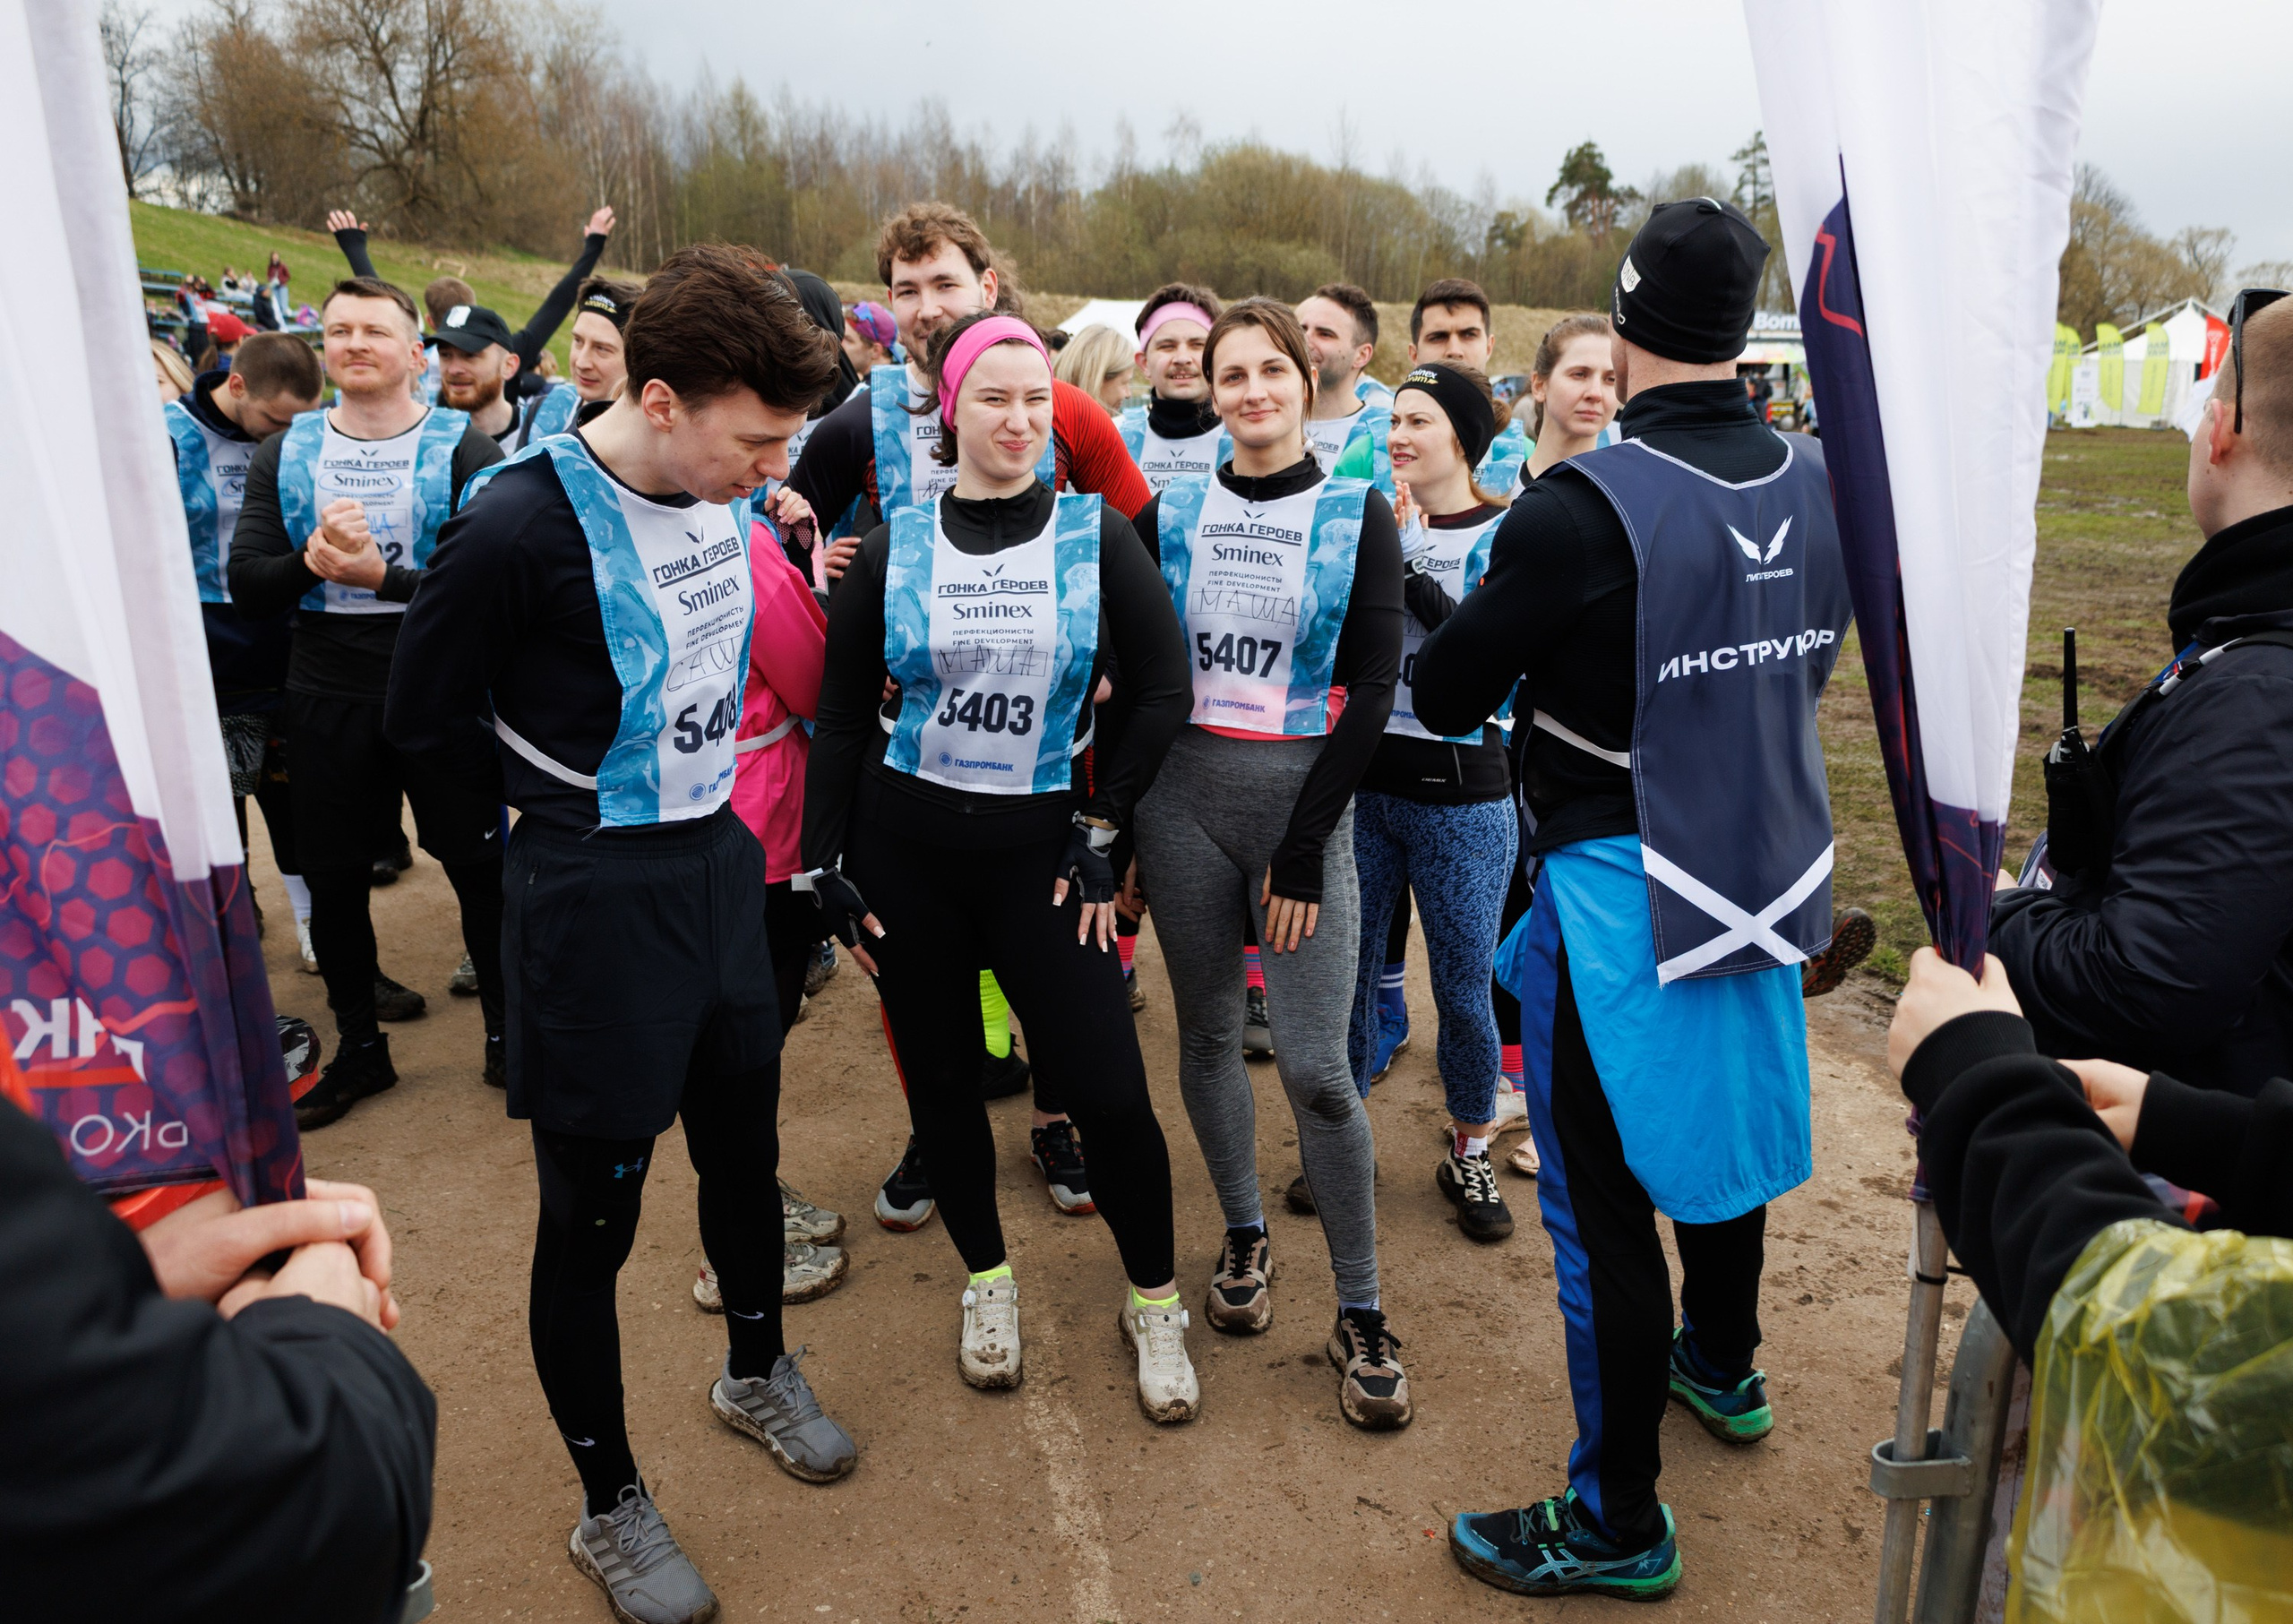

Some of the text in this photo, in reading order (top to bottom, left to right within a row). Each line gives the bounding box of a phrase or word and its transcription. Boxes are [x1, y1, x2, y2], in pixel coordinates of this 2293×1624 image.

[323, 460, 409, 468] ГОНКА ГЕРОЕВ
[1142, 460, 1210, 470] ГОНКА ГЕРОЕВ
[333, 473, 395, 487] Sminex
[1201, 523, 1303, 542] ГОНКА ГЕРОЕВ
[652, 537, 740, 583] ГОНКА ГЕРОЕВ
[1211, 543, 1284, 567] Sminex
[1208, 571, 1283, 583] ПЕРФЕКЦИОНИСТЫ
[938, 580, 1048, 595] ГОНКА ГЕРОЕВ
[1226, 580, 1281, 592] DEVELOPMENT
[677, 574, 741, 616] Sminex
[952, 601, 1034, 620] Sminex
[687, 606, 744, 638] ПЕРФЕКЦИОНИСТЫ
[952, 628, 1034, 636] ПЕРФЕКЦИОНИСТЫ
[685, 638, 699, 649] FINE
[1196, 632, 1282, 678] 5407
[938, 687, 1034, 736] 5403
[1212, 699, 1266, 713] ГАЗПРОМБАНК
[955, 758, 1014, 771] ГАЗПРОМБАНК
